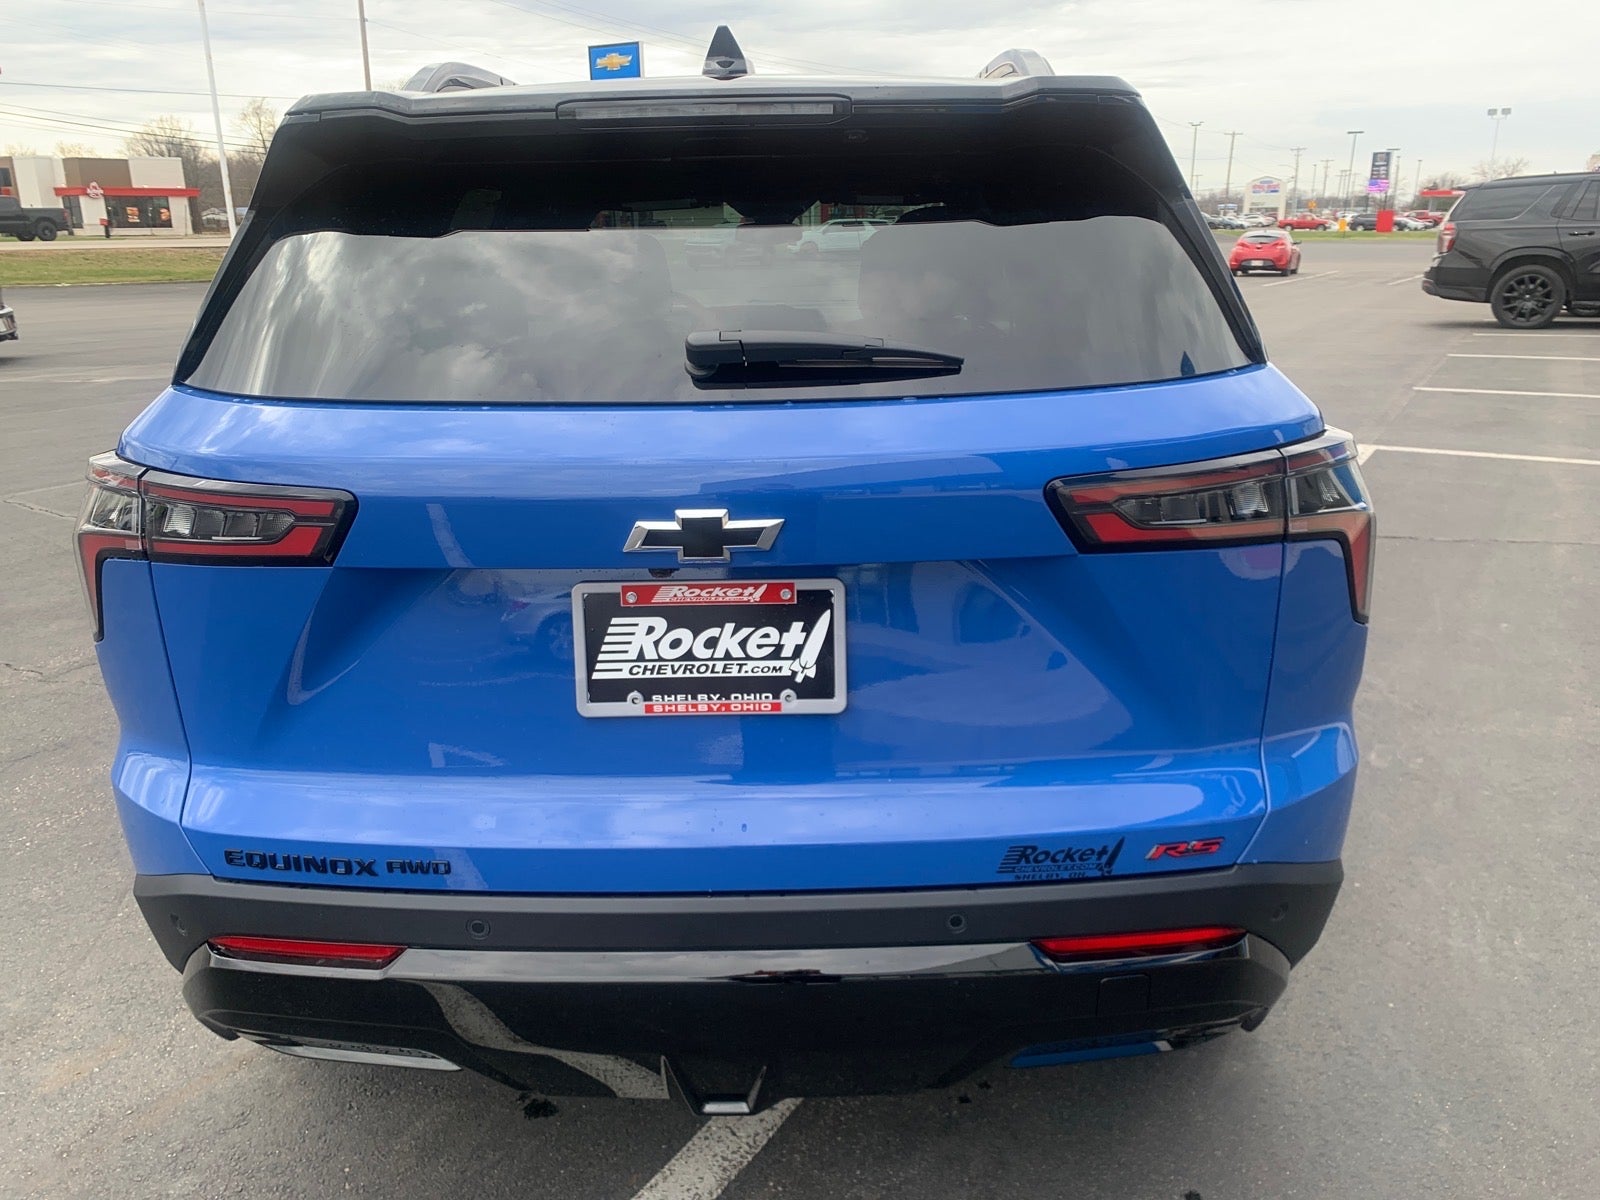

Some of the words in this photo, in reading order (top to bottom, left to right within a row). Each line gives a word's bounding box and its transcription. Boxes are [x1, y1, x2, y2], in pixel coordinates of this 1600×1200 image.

[655, 585, 756, 598] Rocket
[598, 616, 808, 661] Rocket
[652, 703, 726, 713] SHELBY,
[730, 702, 772, 712] OHIO
[730, 692, 773, 701] OHIO
[1000, 844, 1109, 866] Rocket
[1145, 836, 1225, 862] RS
[224, 848, 379, 877] EQUINOX
[386, 858, 452, 876] AWD
